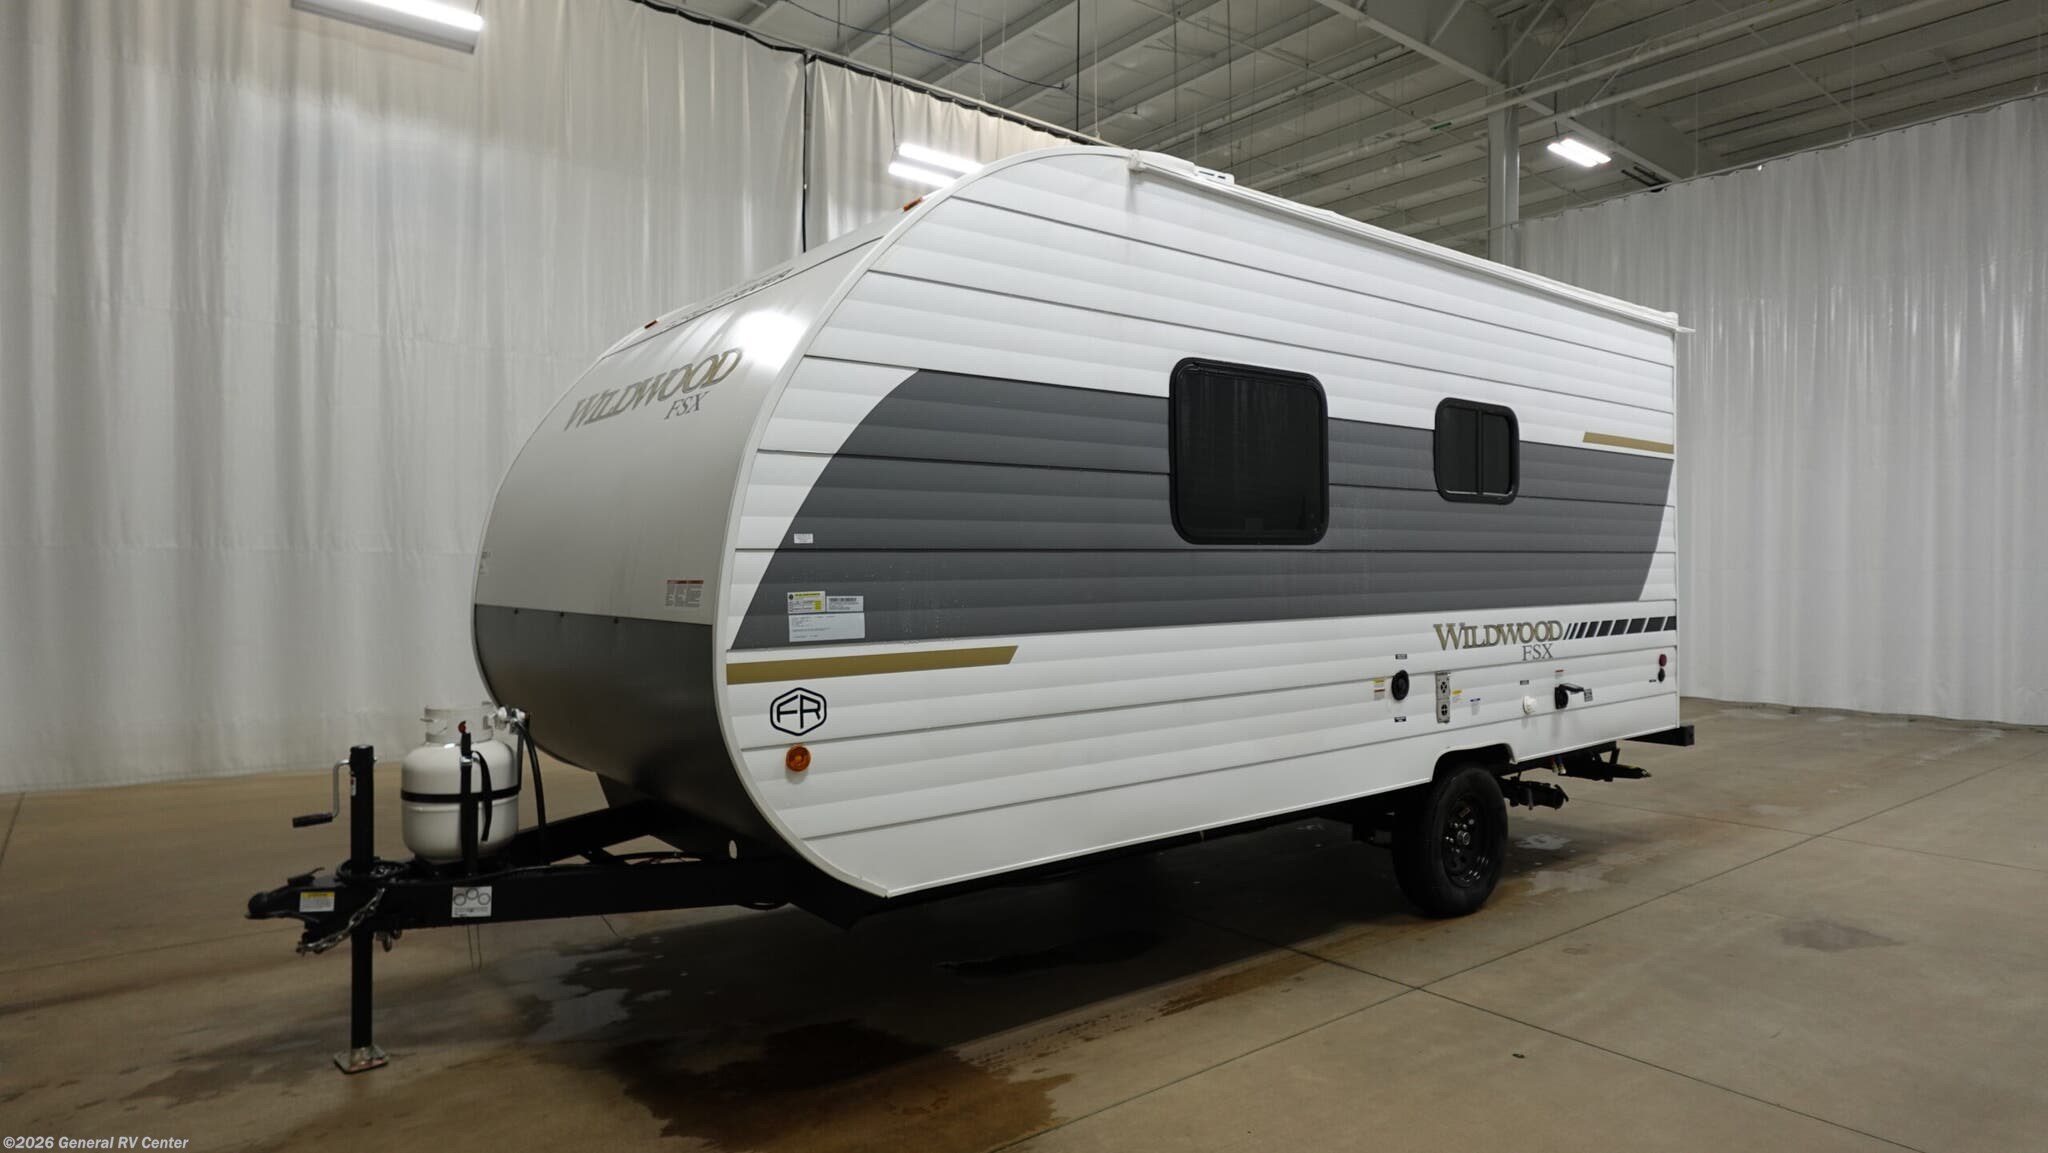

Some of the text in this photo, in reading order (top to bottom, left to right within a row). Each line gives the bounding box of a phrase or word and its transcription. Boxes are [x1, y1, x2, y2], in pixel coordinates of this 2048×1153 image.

[563, 347, 743, 432] WILDWOOD
[663, 391, 711, 421] FSX
[1433, 620, 1564, 651] WILDWOOD
[1522, 643, 1553, 661] FSX
